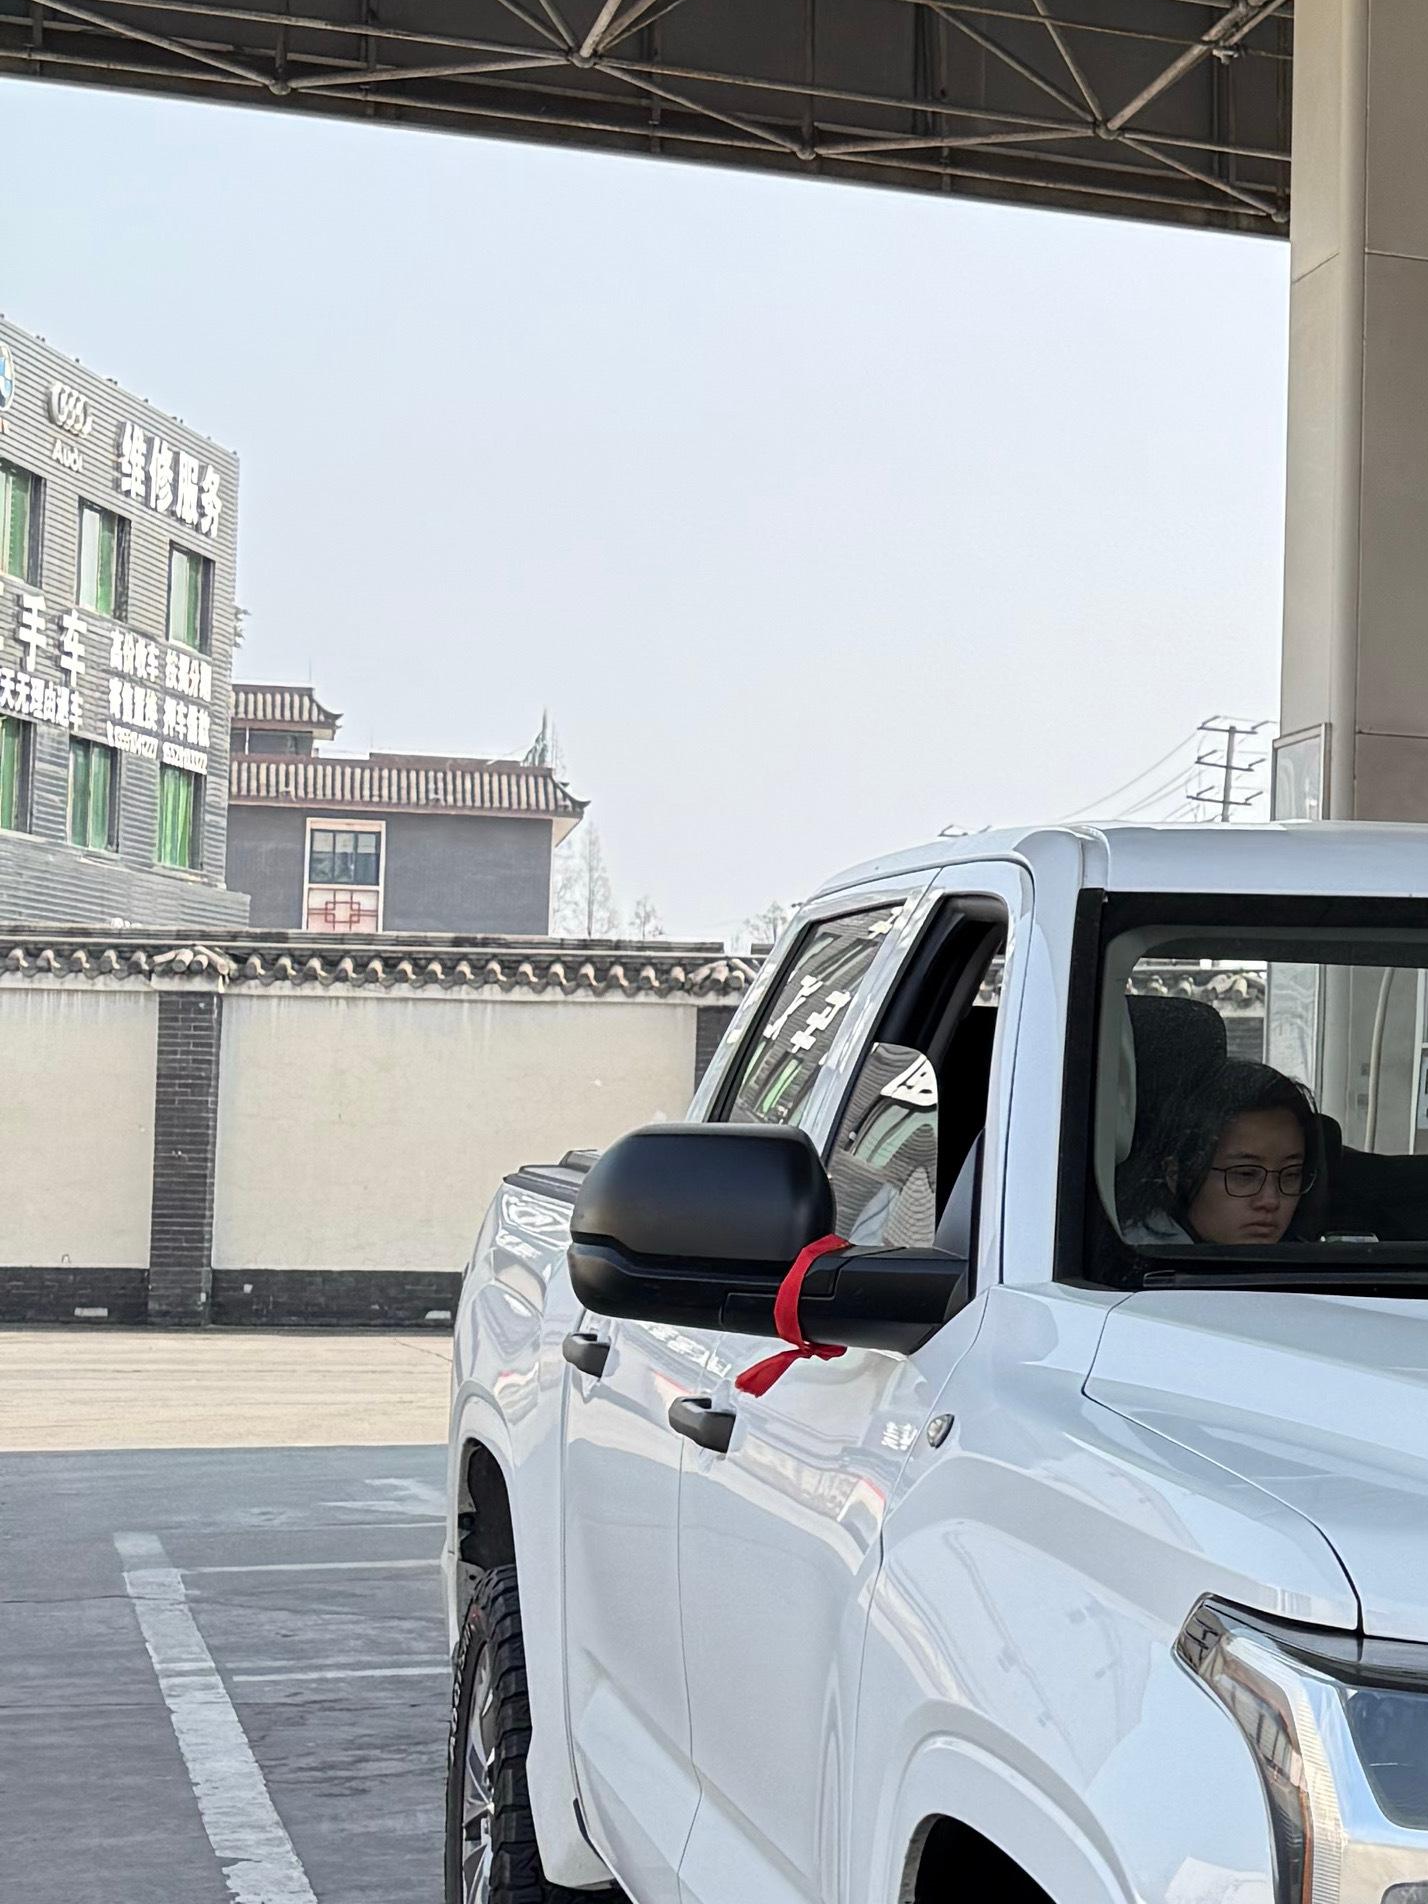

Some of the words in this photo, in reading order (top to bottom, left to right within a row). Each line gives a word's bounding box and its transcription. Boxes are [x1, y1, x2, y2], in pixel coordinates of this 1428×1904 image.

[51, 438, 84, 473] Audi
[119, 421, 222, 538] 维修服务
[0, 581, 87, 687] 手车
